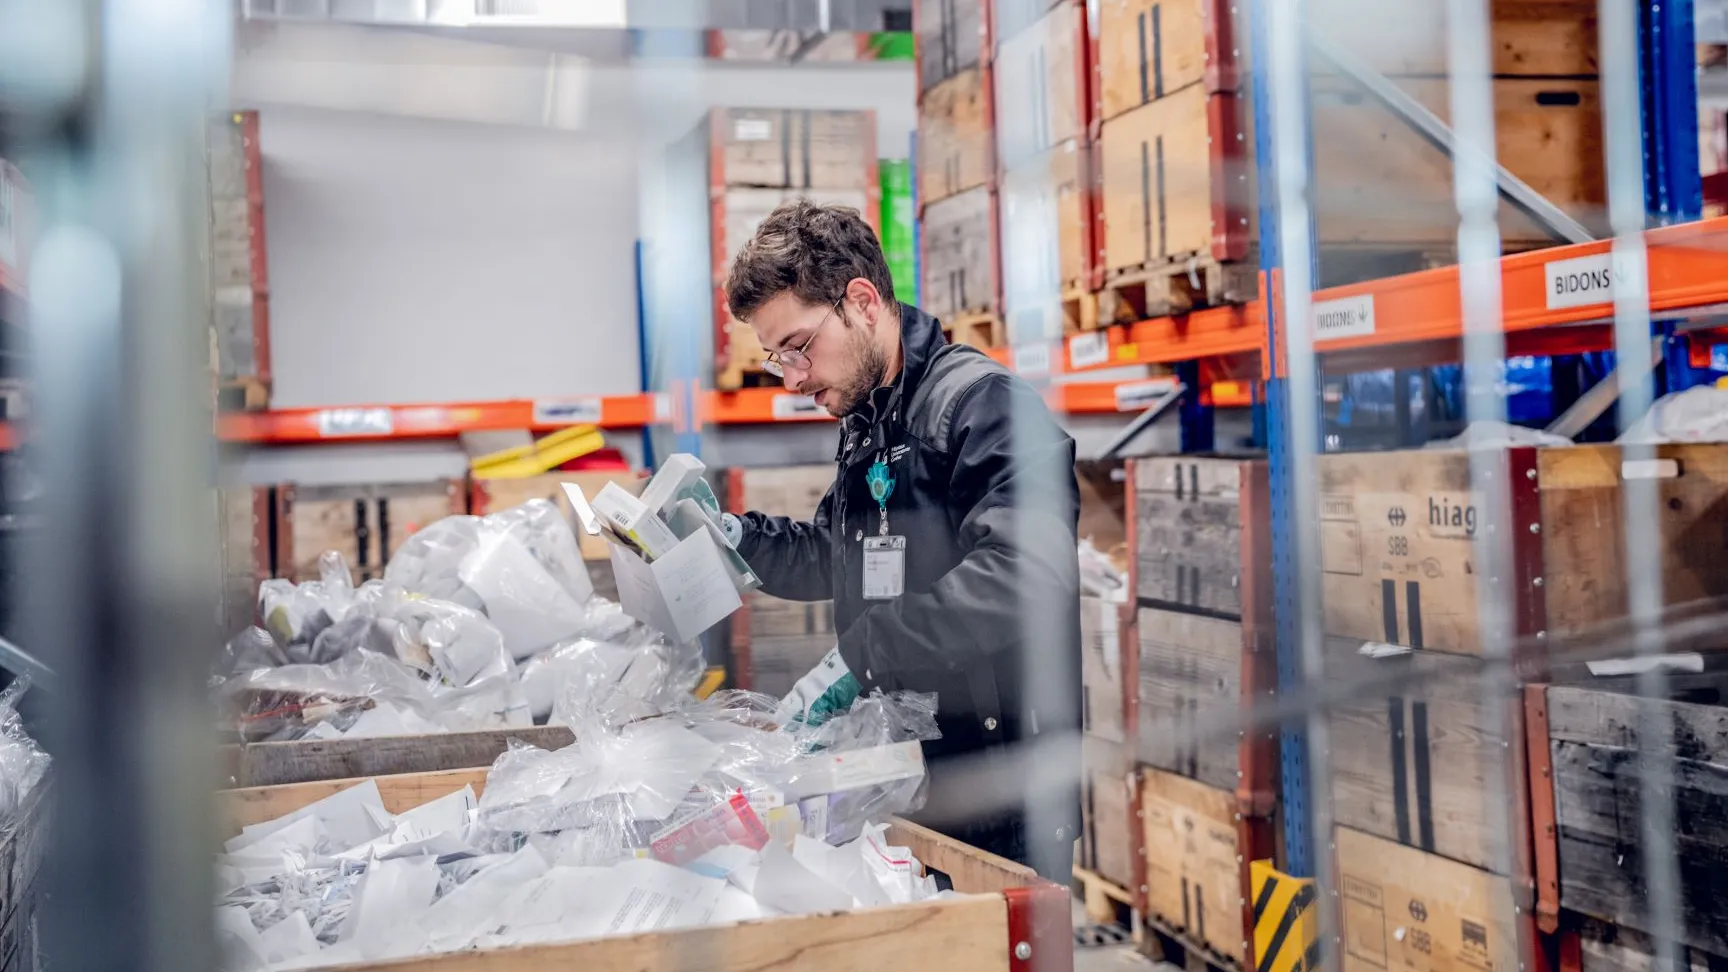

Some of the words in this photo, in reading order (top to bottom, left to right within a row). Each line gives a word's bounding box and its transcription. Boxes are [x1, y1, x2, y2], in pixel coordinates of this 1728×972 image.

[1555, 269, 1610, 295] BIDONS
[1428, 497, 1477, 536] hiag
[1387, 536, 1408, 556] SBB
